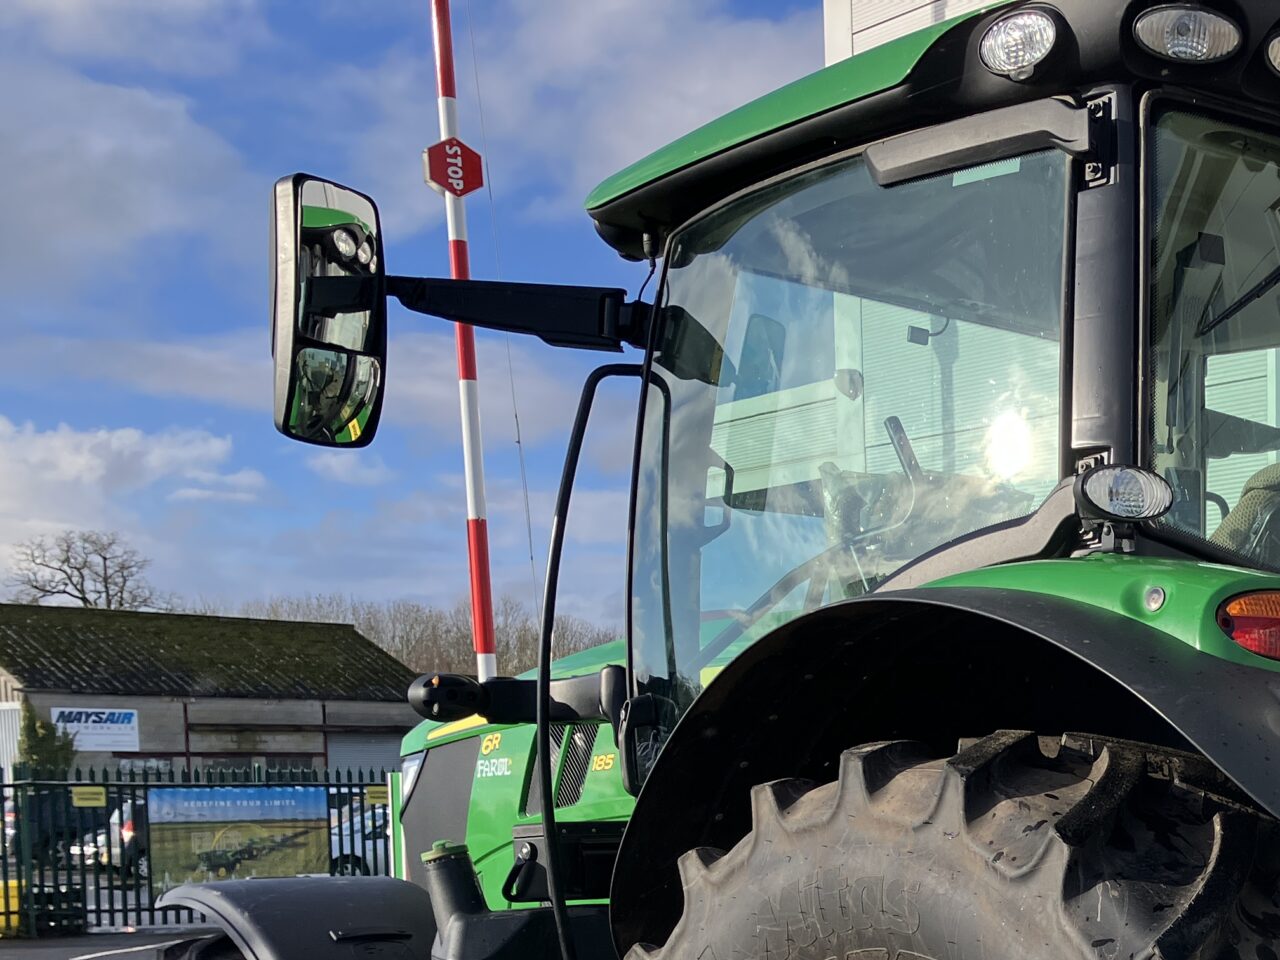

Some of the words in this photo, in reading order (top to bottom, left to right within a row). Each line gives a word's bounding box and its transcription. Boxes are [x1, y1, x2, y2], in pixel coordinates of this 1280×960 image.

[445, 144, 464, 190] STOP
[56, 710, 134, 724] MAYSAIR
[481, 733, 502, 755] 6R
[477, 758, 511, 778] FAROL
[591, 754, 615, 772] 185
